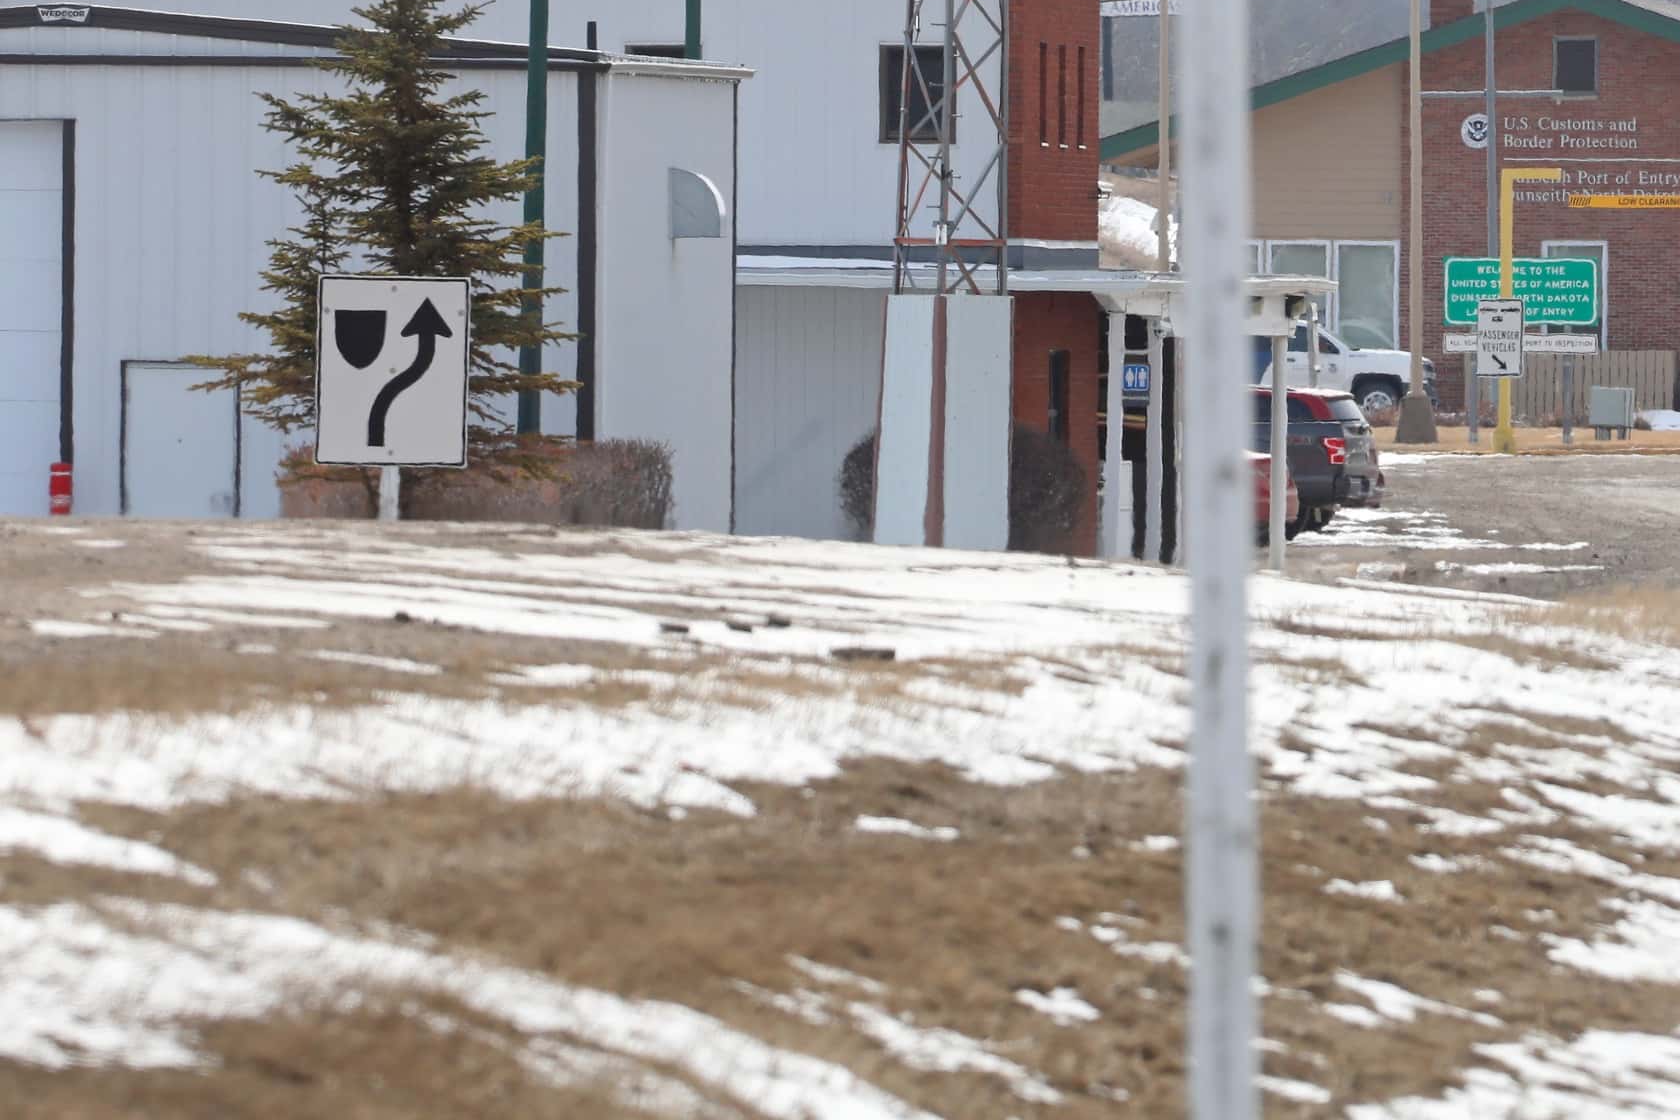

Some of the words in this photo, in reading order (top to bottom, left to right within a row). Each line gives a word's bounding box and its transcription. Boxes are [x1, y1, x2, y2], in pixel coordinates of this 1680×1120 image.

[1538, 117, 1604, 131] Customs
[1608, 117, 1637, 132] and
[1504, 134, 1552, 148] Border
[1560, 134, 1637, 149] Protection
[1578, 171, 1608, 184] Port
[1616, 171, 1632, 184] of
[1639, 171, 1680, 187] Entry
[1618, 198, 1637, 206] LOW
[1530, 266, 1542, 275] TO
[1545, 266, 1565, 275] THE
[1451, 280, 1487, 288] UNITED
[1530, 280, 1542, 288] OF
[1545, 280, 1589, 288] AMERICA
[1547, 294, 1590, 302] DAKOTA
[1526, 307, 1539, 316] OF
[1543, 307, 1575, 316] ENTRY
